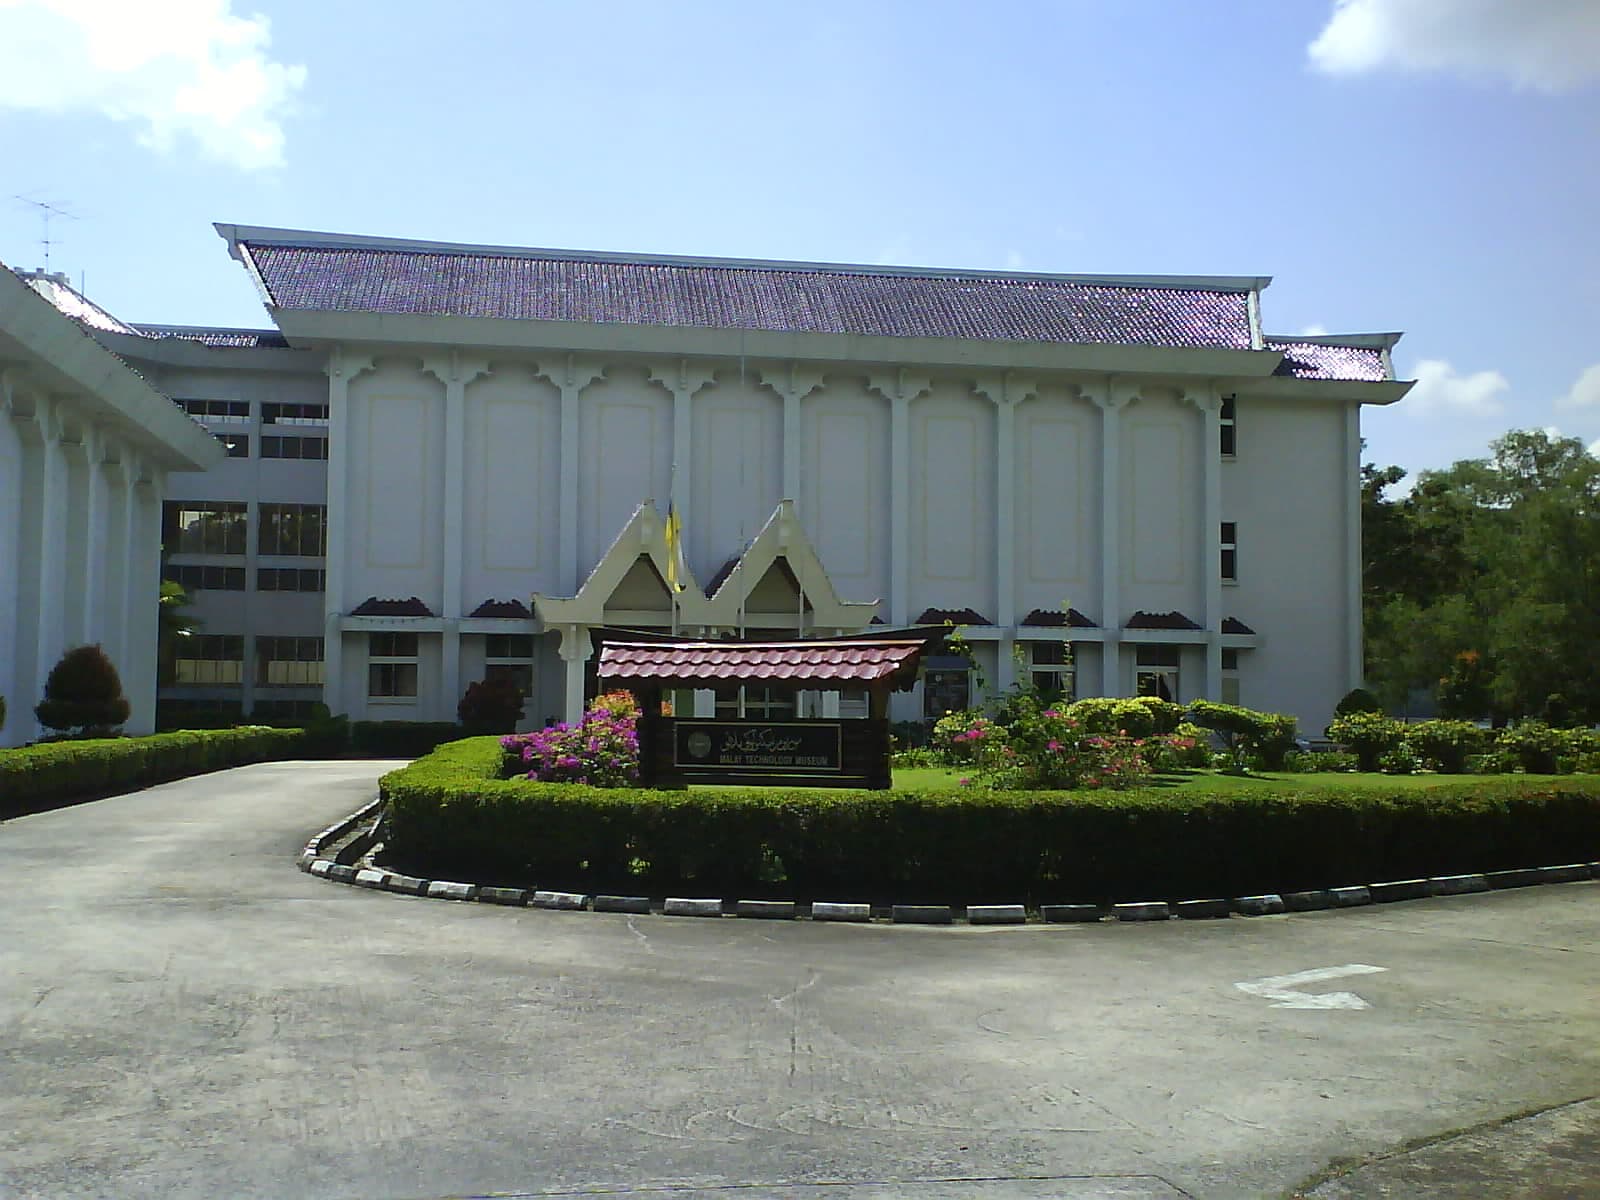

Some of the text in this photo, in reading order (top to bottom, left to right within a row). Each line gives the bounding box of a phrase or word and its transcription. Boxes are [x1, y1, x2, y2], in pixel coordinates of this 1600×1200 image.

[720, 755, 828, 766] MALAY TECHNOLOGY MUSEUM
